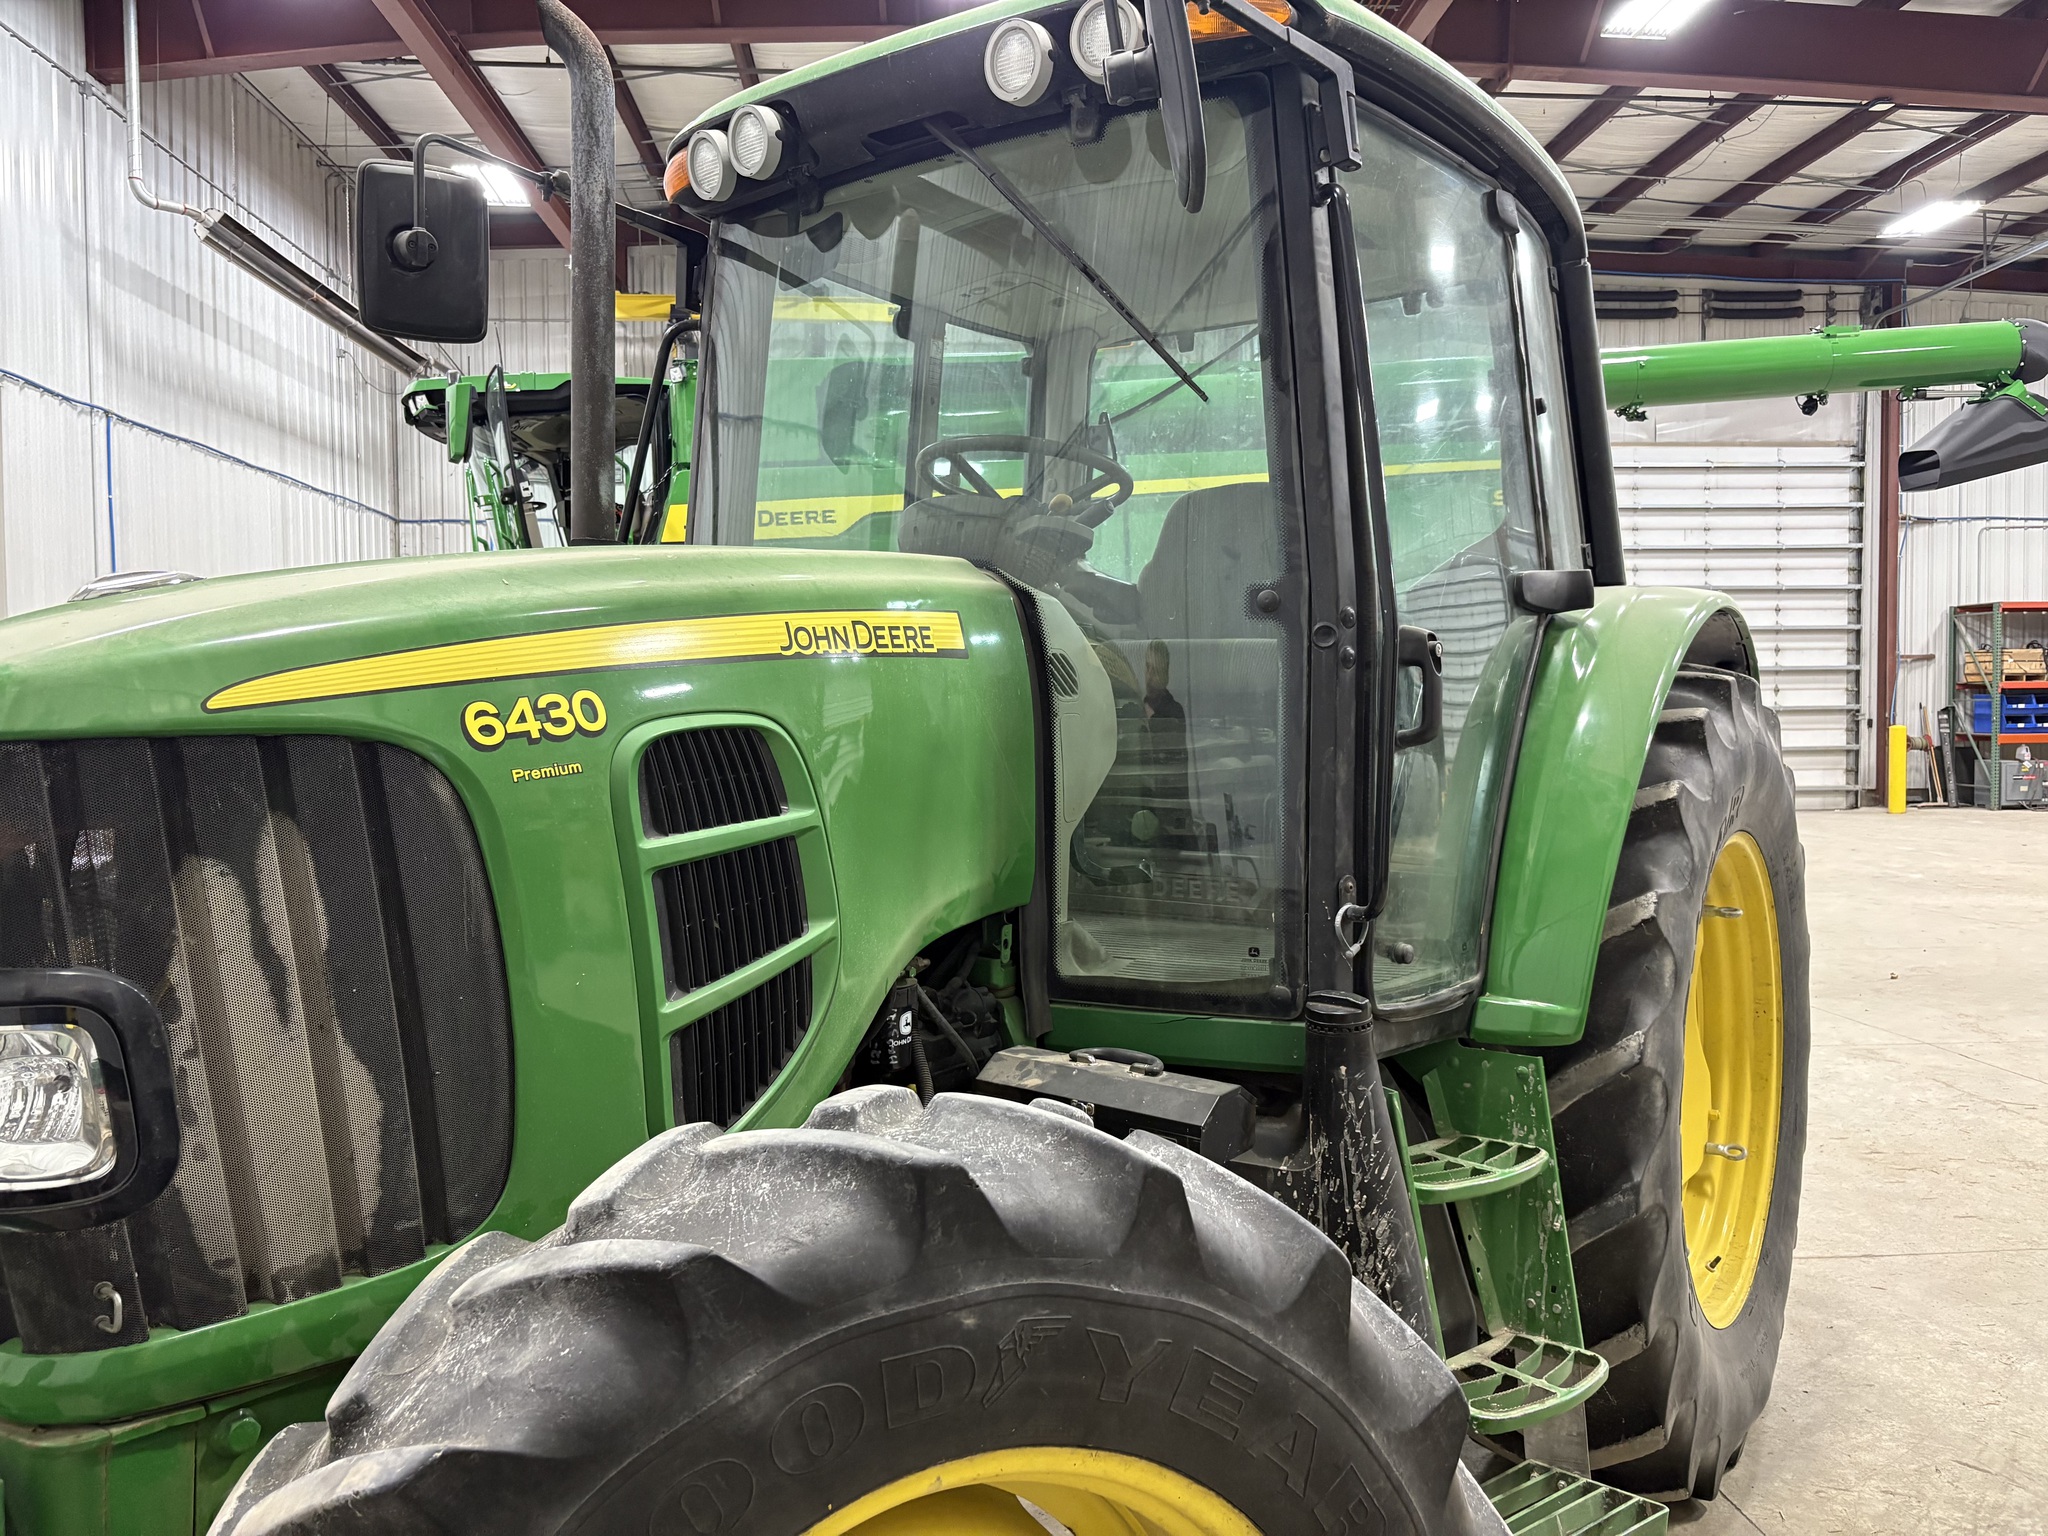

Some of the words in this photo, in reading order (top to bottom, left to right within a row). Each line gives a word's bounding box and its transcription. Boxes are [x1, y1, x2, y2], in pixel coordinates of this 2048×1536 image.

[757, 509, 837, 527] DEERE
[780, 621, 850, 652] JOHN
[851, 620, 936, 651] DEERE
[460, 688, 608, 752] 6430
[511, 762, 583, 783] Premium
[649, 1328, 1387, 1536] OODYEAR
